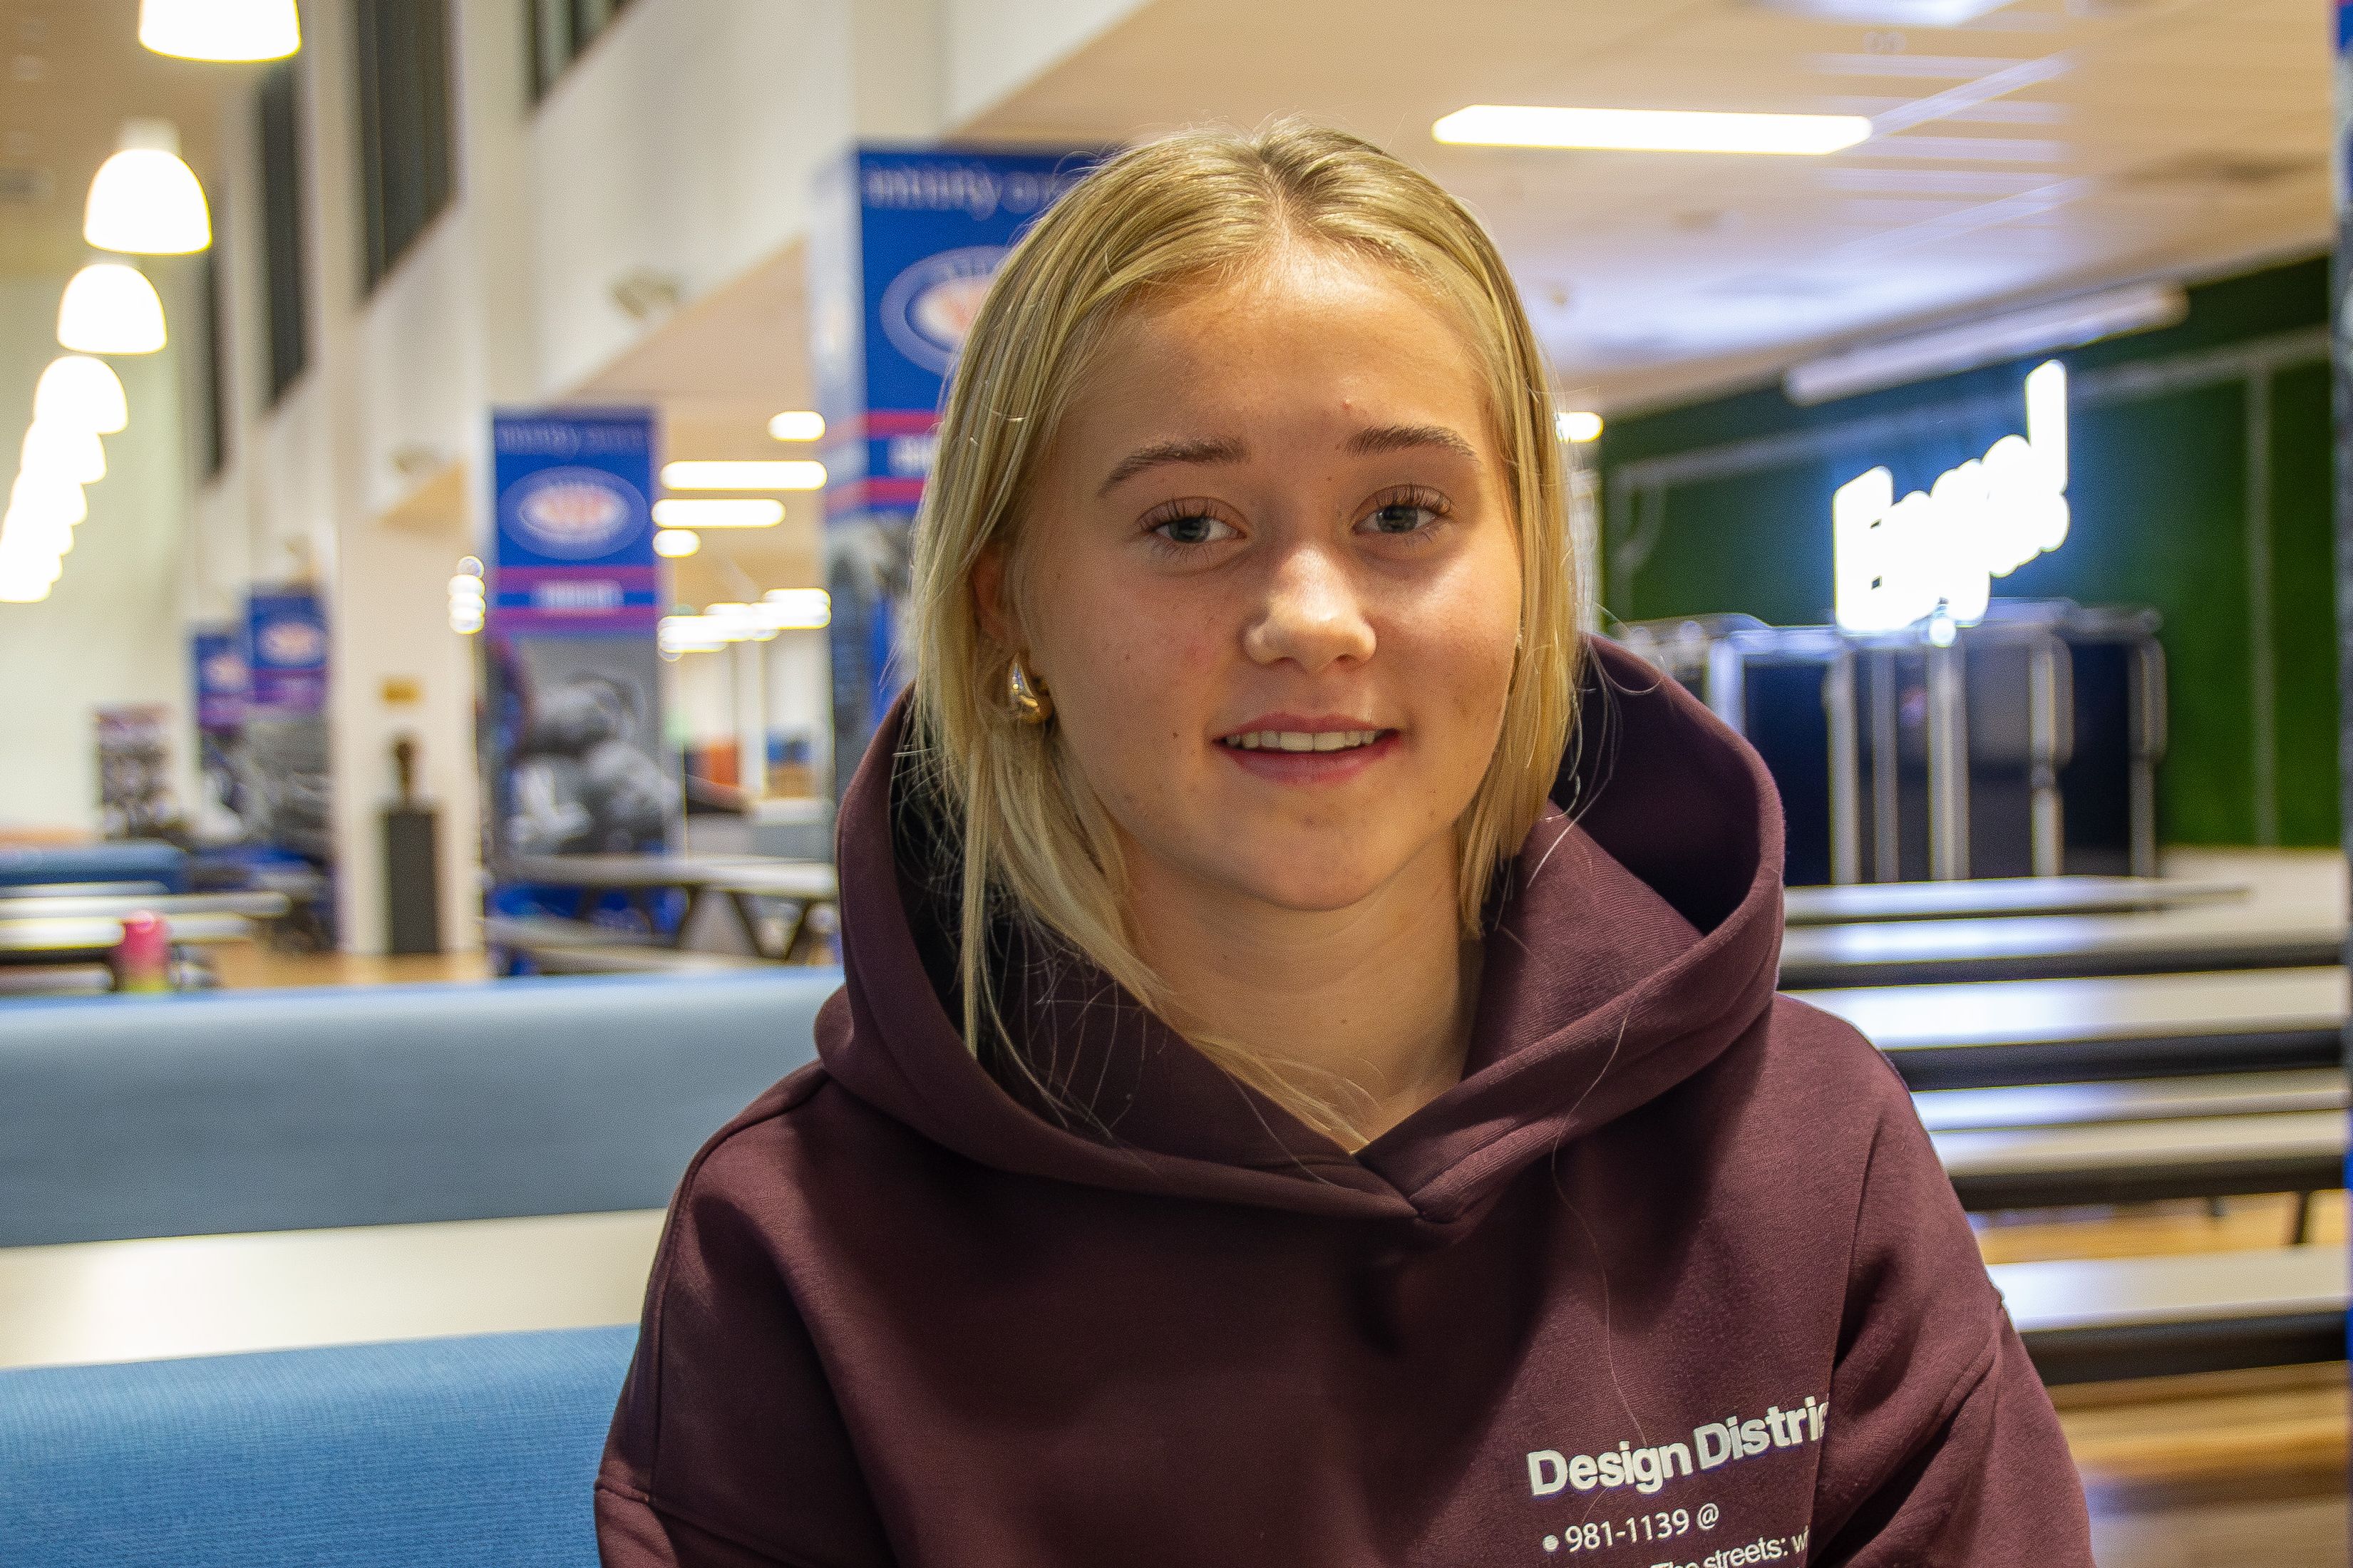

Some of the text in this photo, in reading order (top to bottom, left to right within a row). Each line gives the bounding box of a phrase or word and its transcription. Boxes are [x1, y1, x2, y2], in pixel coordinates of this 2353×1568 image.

[1527, 1440, 1692, 1495] Design
[1565, 1502, 1719, 1552] 981-1139 @
